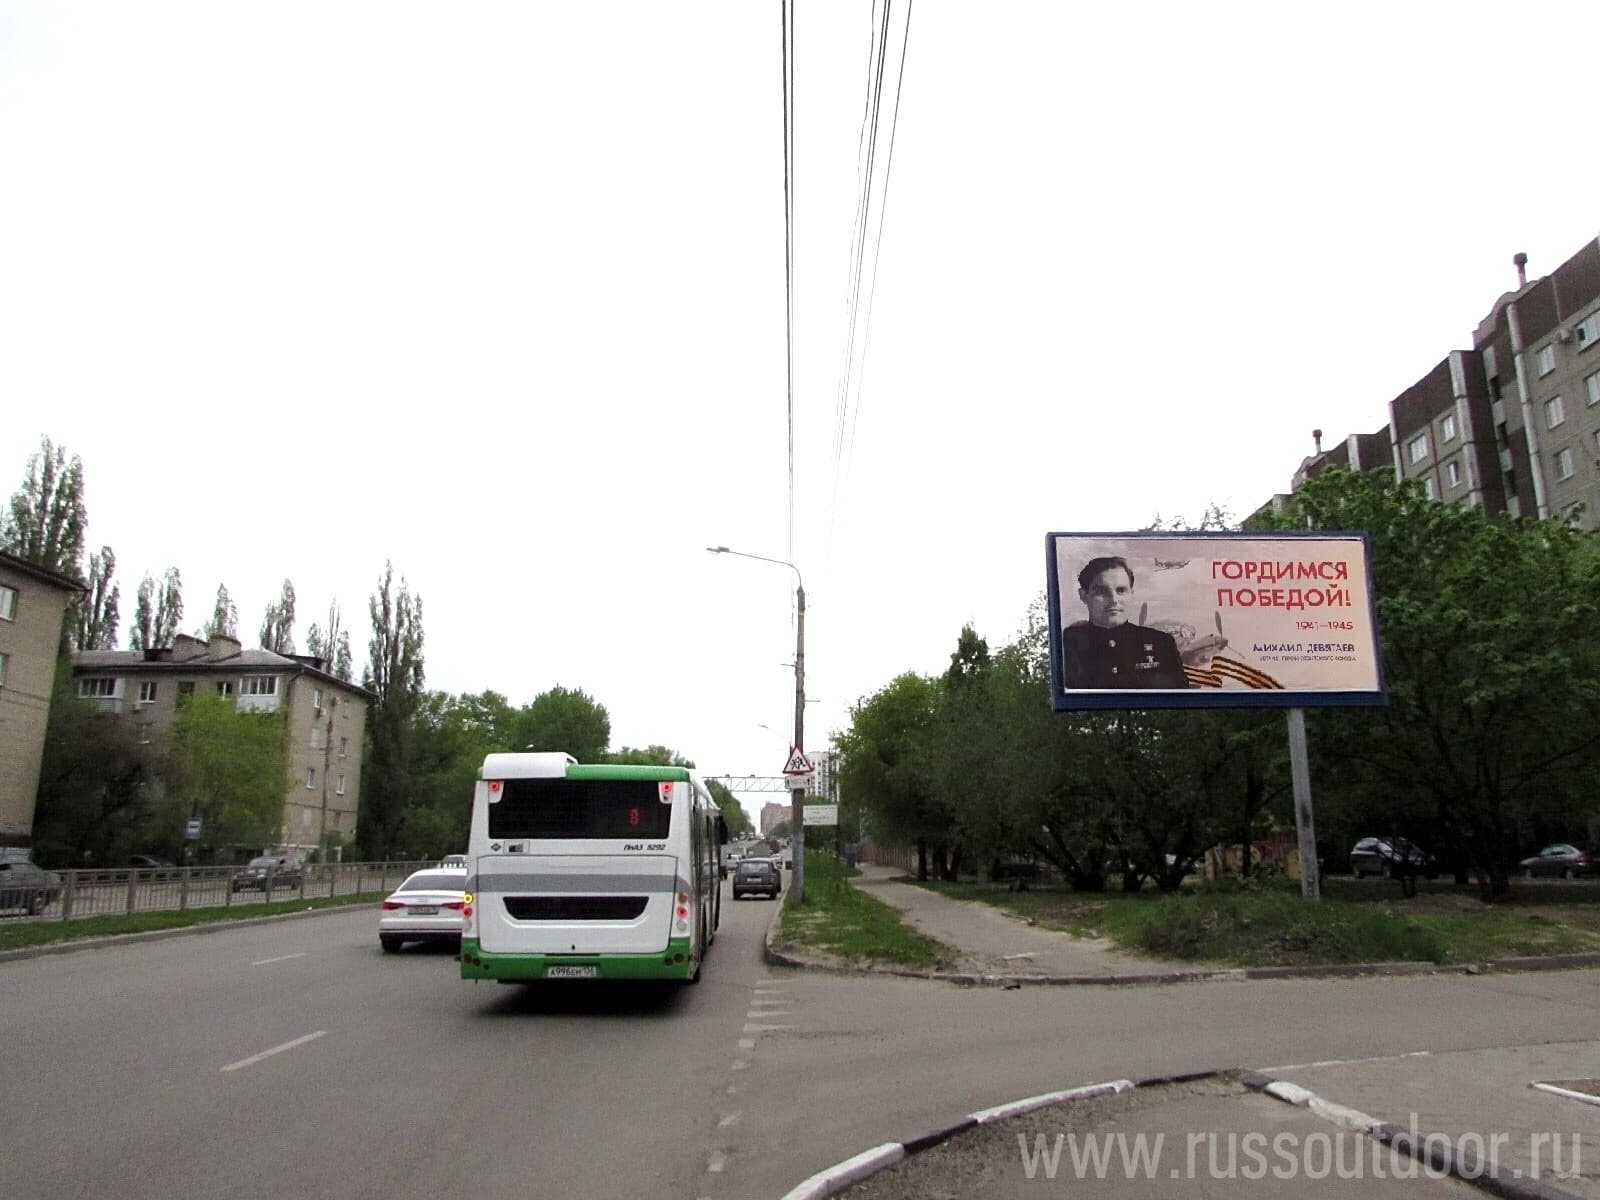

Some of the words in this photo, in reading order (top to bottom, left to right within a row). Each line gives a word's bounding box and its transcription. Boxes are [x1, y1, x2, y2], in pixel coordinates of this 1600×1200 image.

[1212, 561, 1348, 584] ГОРДИМСЯ
[1217, 583, 1352, 611] ПОБЕДОЙ!
[1253, 643, 1303, 652] МИХАИЛ
[1307, 643, 1356, 654] ДЕВЯТАЕВ
